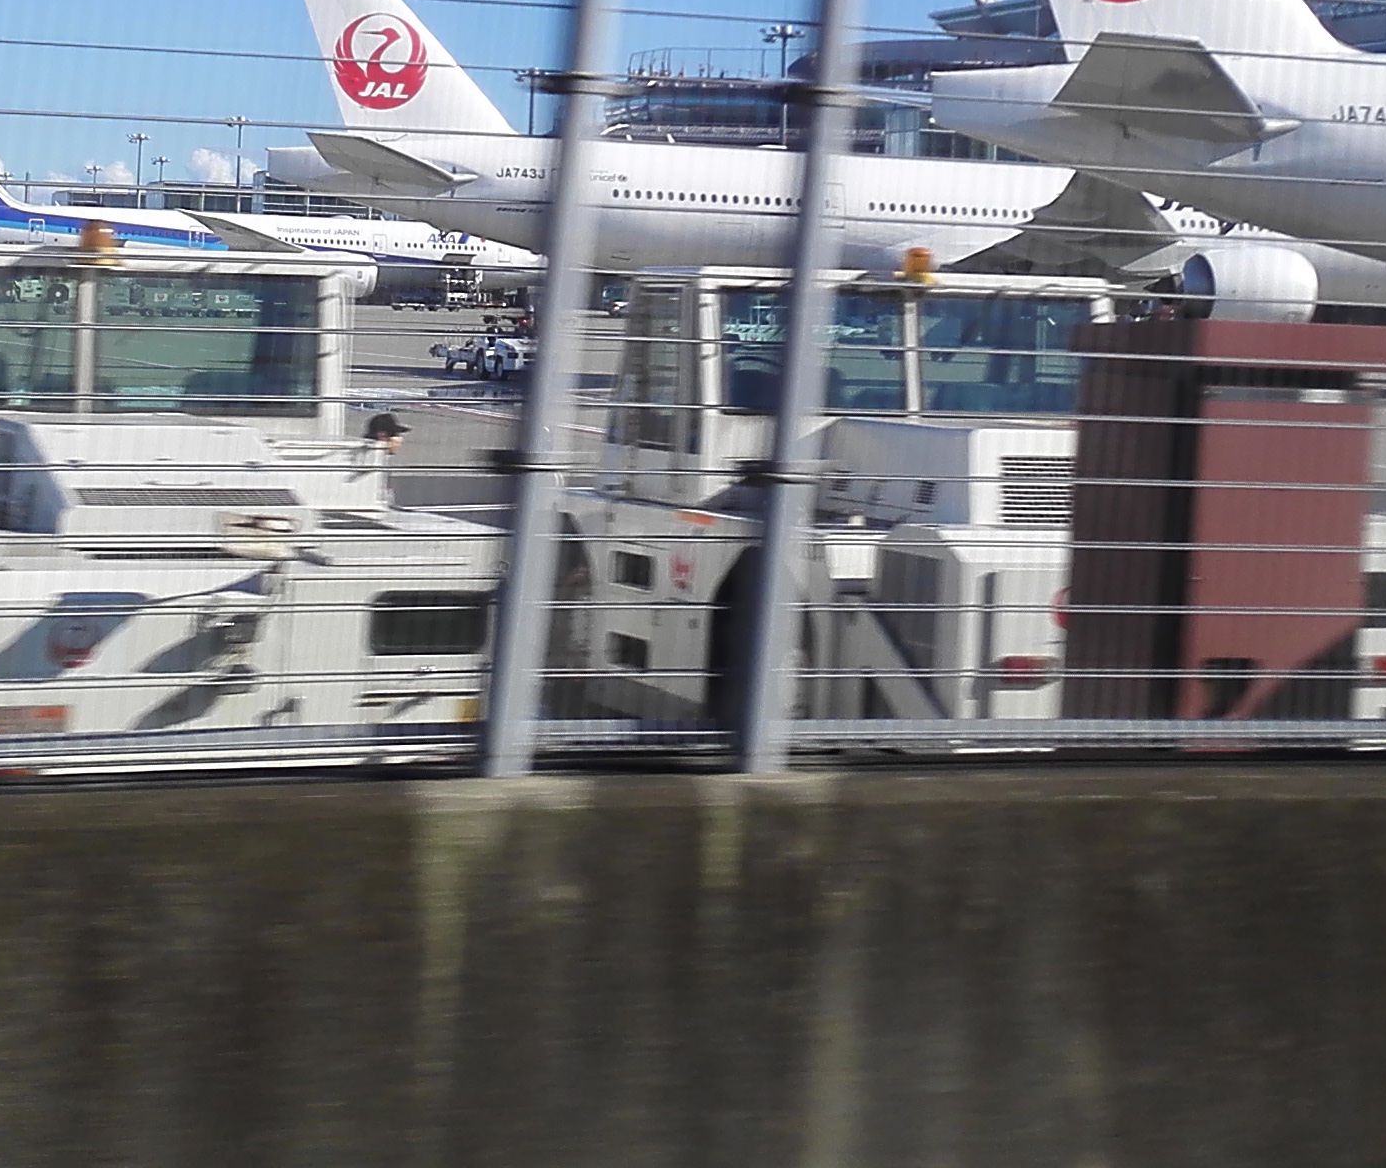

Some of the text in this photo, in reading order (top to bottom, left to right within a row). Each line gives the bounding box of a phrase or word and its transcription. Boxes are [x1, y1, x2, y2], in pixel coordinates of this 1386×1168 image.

[357, 81, 409, 99] JAL
[495, 167, 546, 180] JA743J
[276, 226, 322, 235] Inspiration
